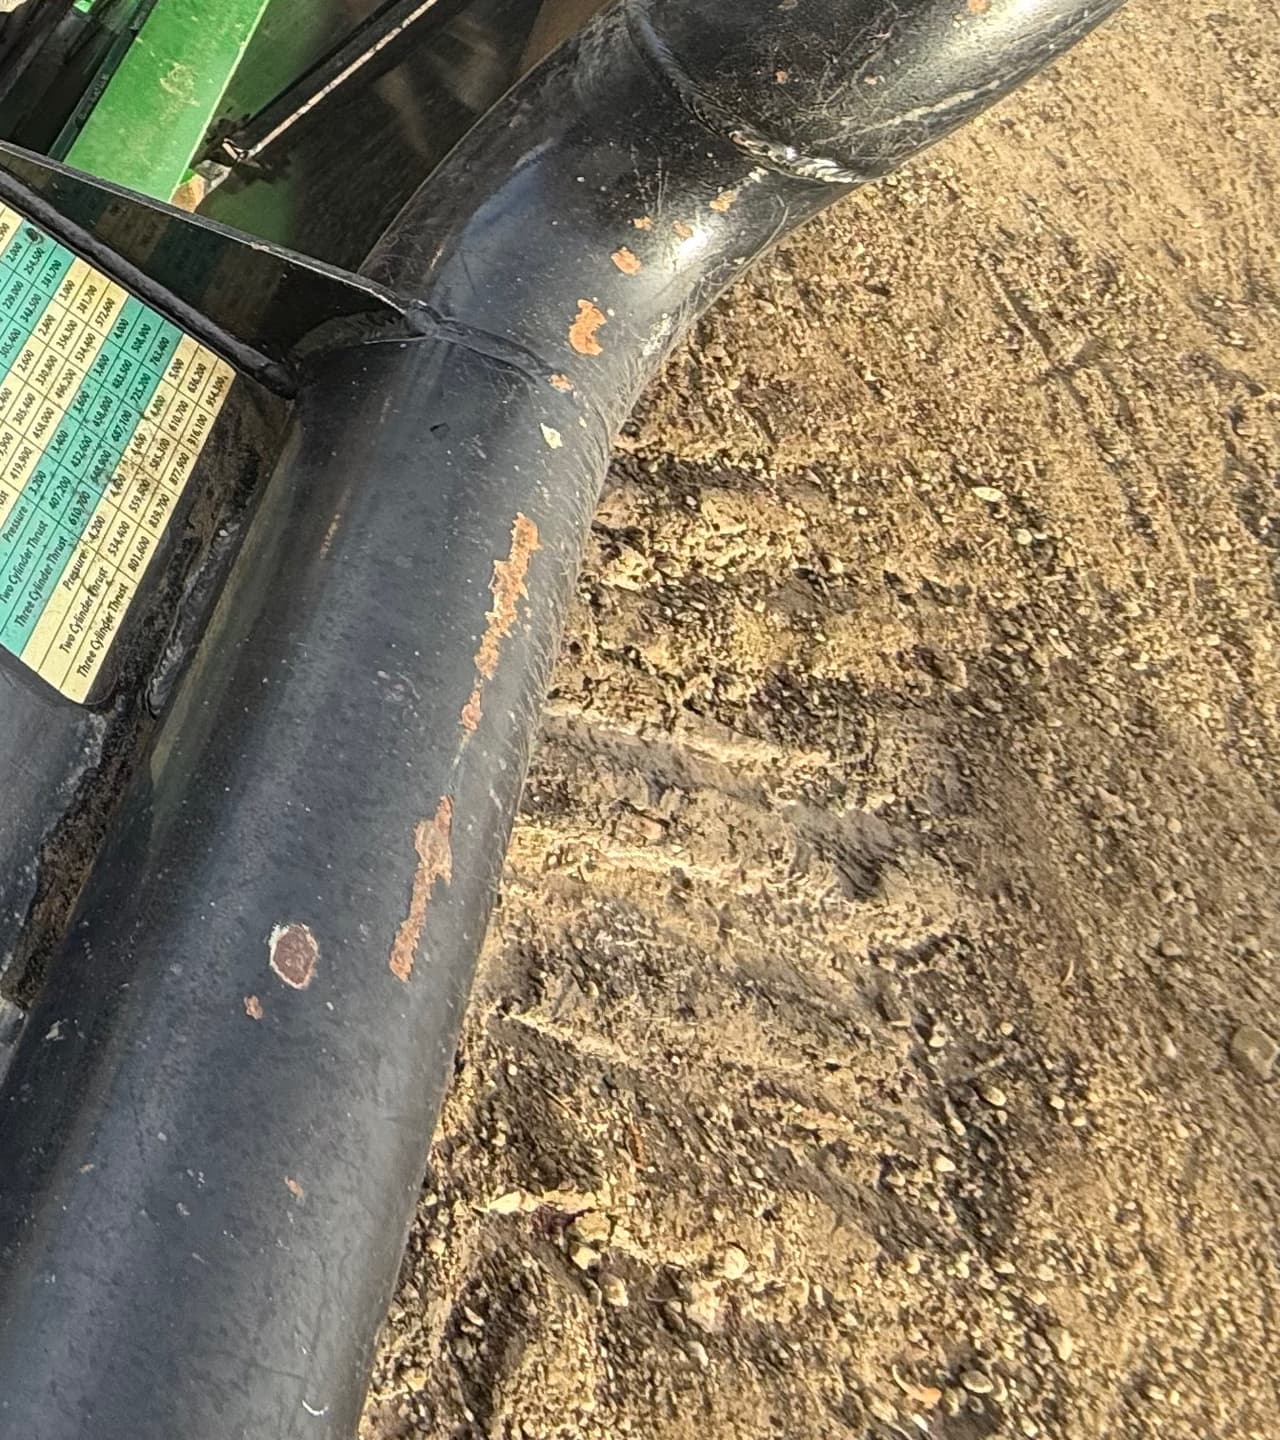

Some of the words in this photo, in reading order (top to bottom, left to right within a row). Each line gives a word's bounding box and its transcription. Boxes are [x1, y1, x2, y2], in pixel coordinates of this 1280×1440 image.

[1, 505, 29, 544] Pressure
[8, 547, 33, 585] Cylinder
[26, 520, 49, 549] Thrust
[13, 600, 35, 628] Three
[28, 563, 54, 602] Cylinder
[45, 535, 68, 565] Thrust
[62, 548, 88, 592] Pressure
[58, 633, 76, 654] Two
[68, 590, 95, 635] Cylinder
[85, 566, 109, 598] Thrust
[75, 650, 97, 678] Three
[89, 606, 115, 651] Cylinder
[107, 582, 129, 613] Thrust
